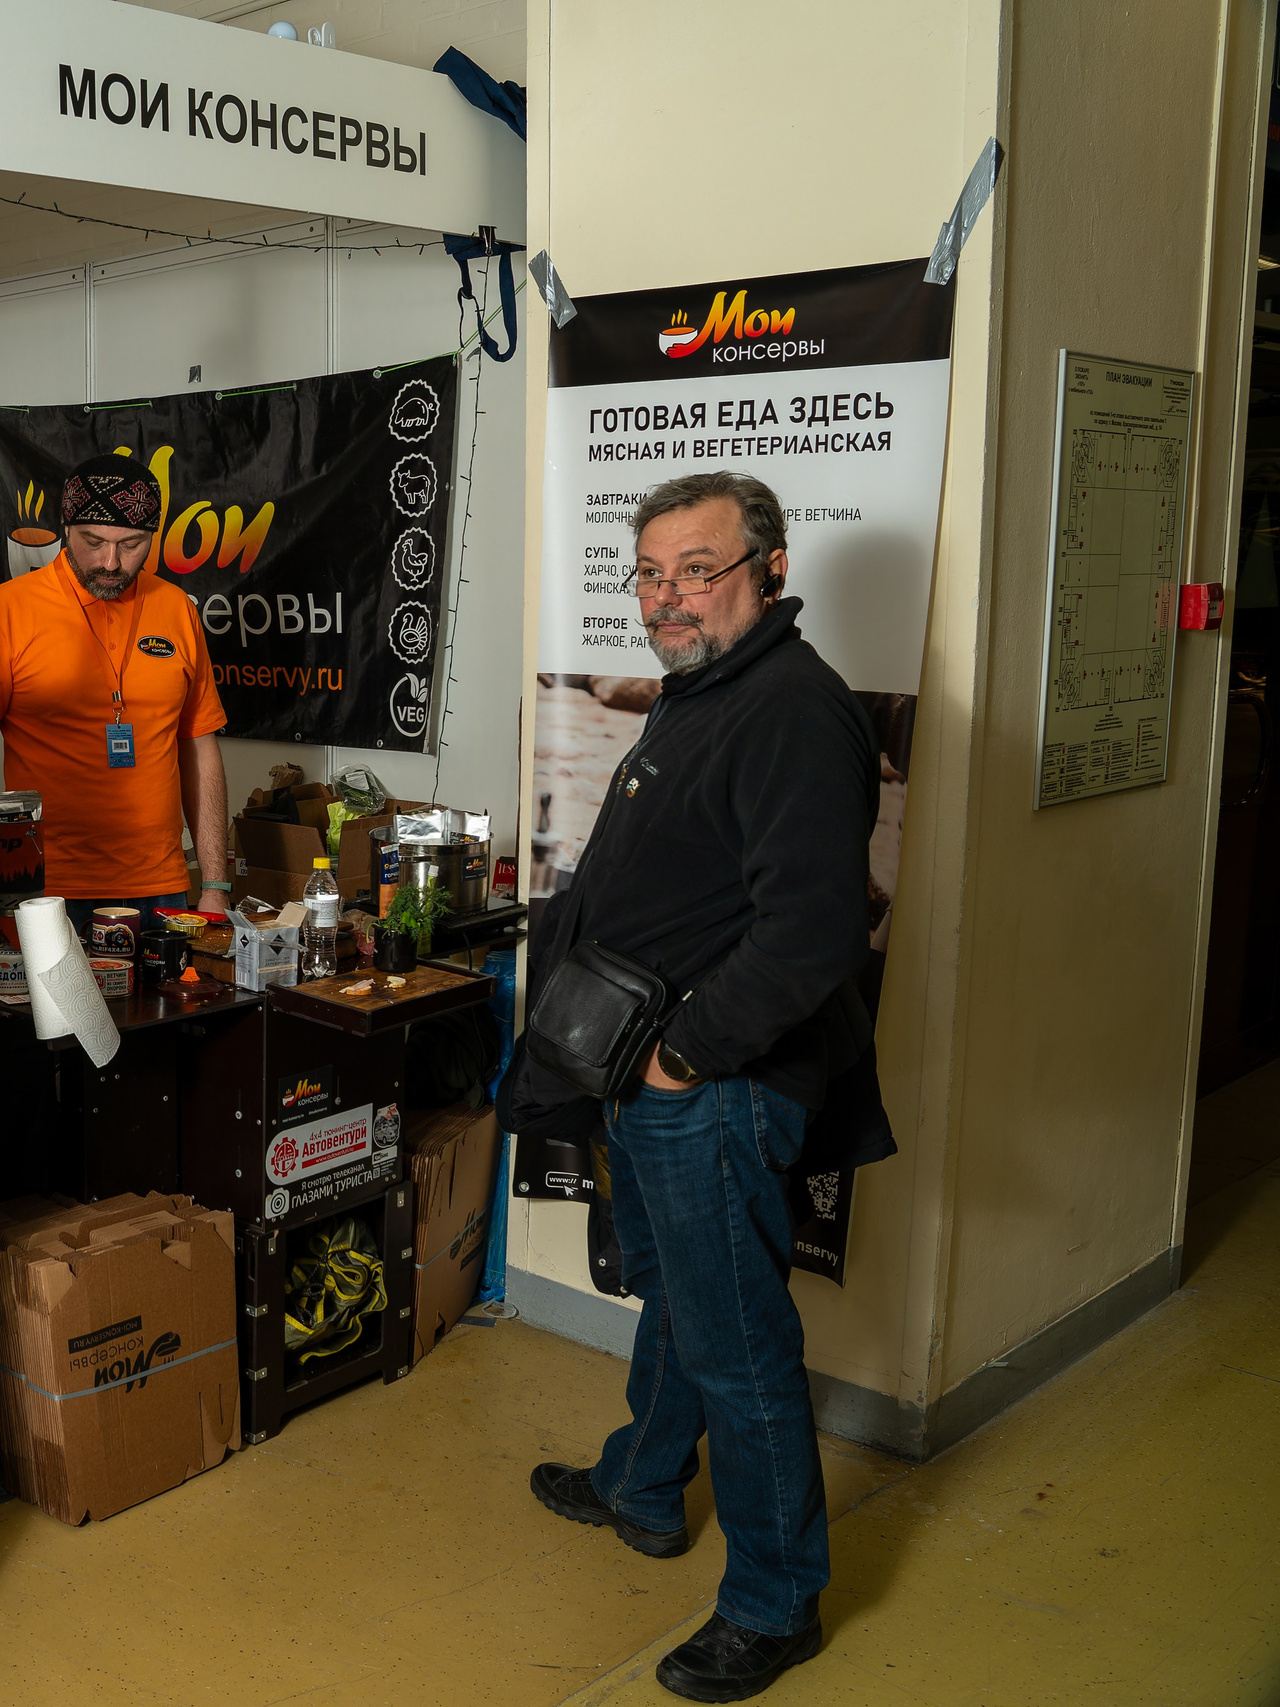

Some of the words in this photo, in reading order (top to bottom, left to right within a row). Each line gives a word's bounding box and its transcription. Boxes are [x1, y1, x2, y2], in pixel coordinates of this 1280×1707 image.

[58, 64, 170, 133] МОИ
[187, 88, 427, 177] КОНСЕРВЫ
[698, 289, 797, 343] Мои
[712, 339, 825, 363] консервы
[589, 402, 707, 434] ГОТОВАЯ
[720, 398, 780, 431] ЕДА
[789, 391, 895, 426] ЗДЕСЬ
[588, 440, 665, 462] МЯСНАЯ
[672, 439, 686, 459] И
[693, 431, 892, 459] ВЕГЕТЕРИАНСКАЯ
[805, 509, 862, 521] ВЕТЧИНА
[585, 547, 619, 559] СУПЫ
[584, 564, 619, 578] ХАРЧО,
[583, 582, 629, 594] ФИНСКА
[187, 591, 343, 647] ервы
[583, 617, 628, 630] ВТОРОЕ
[581, 635, 627, 648] ЖАРКОЕ,
[397, 706, 425, 723] VEG
[294, 1079, 322, 1098] Мои
[297, 1092, 329, 1107] консервы
[302, 1126, 367, 1158] Автовентури
[291, 1184, 334, 1209] ГЛАЗАМИ
[335, 1169, 374, 1193] ТУРИСТА
[301, 1182, 307, 1191] Я
[307, 1174, 332, 1189] смотрю
[332, 1164, 365, 1180] телеканал
[794, 1240, 839, 1267] nservy
[73, 1320, 138, 1349] MOI-KONSERVY.RU
[70, 1336, 144, 1372] консервы
